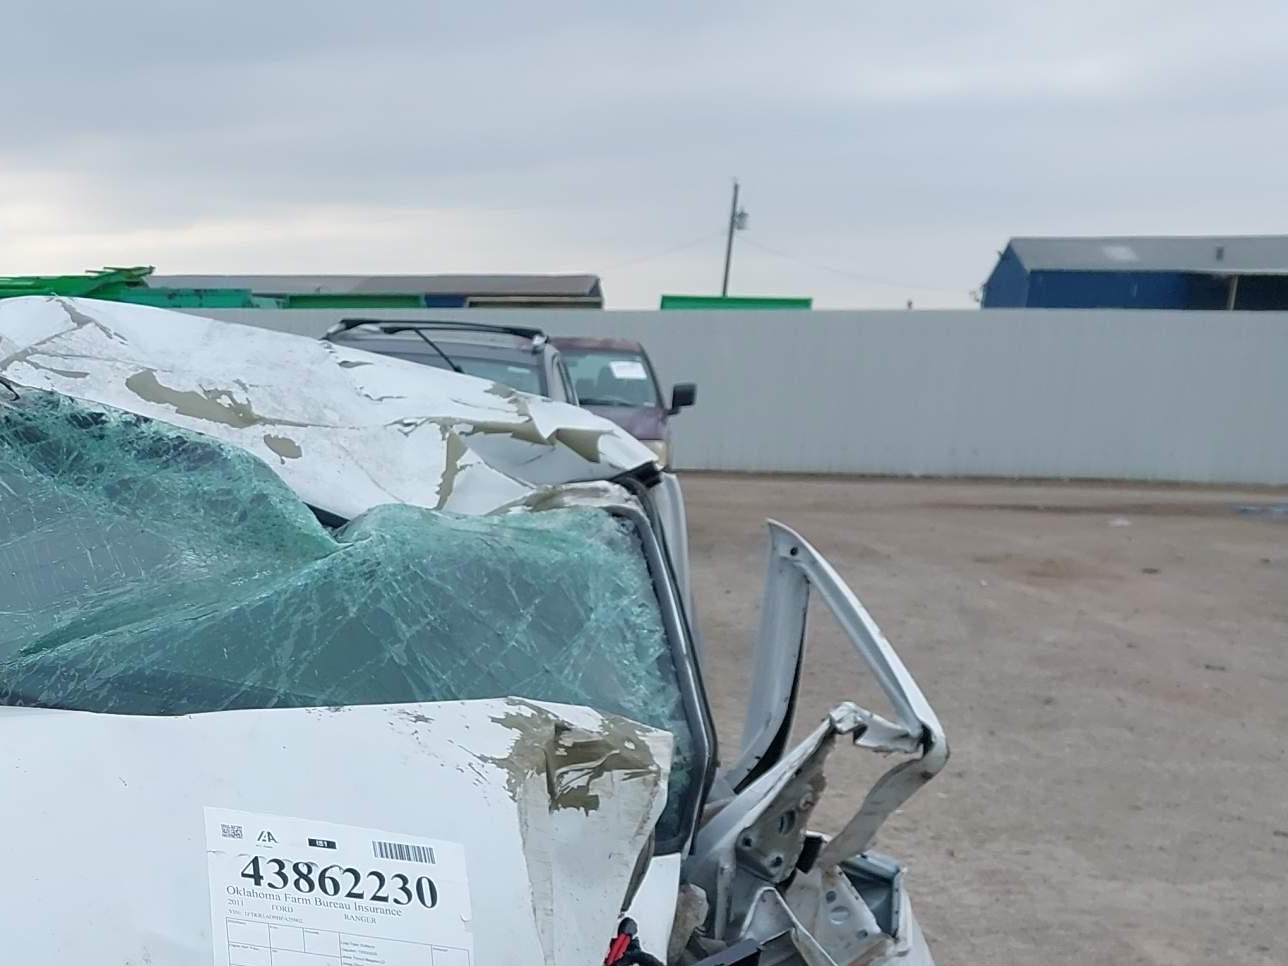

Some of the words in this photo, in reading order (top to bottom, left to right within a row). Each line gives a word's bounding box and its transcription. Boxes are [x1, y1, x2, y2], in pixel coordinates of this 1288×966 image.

[240, 855, 439, 909] 43862230
[226, 885, 281, 901] Oklahoma
[284, 893, 311, 905] Farm
[314, 896, 351, 910] Bureau
[354, 902, 402, 917] Insurance
[271, 904, 294, 913] FORD
[344, 913, 377, 924] RANGER
